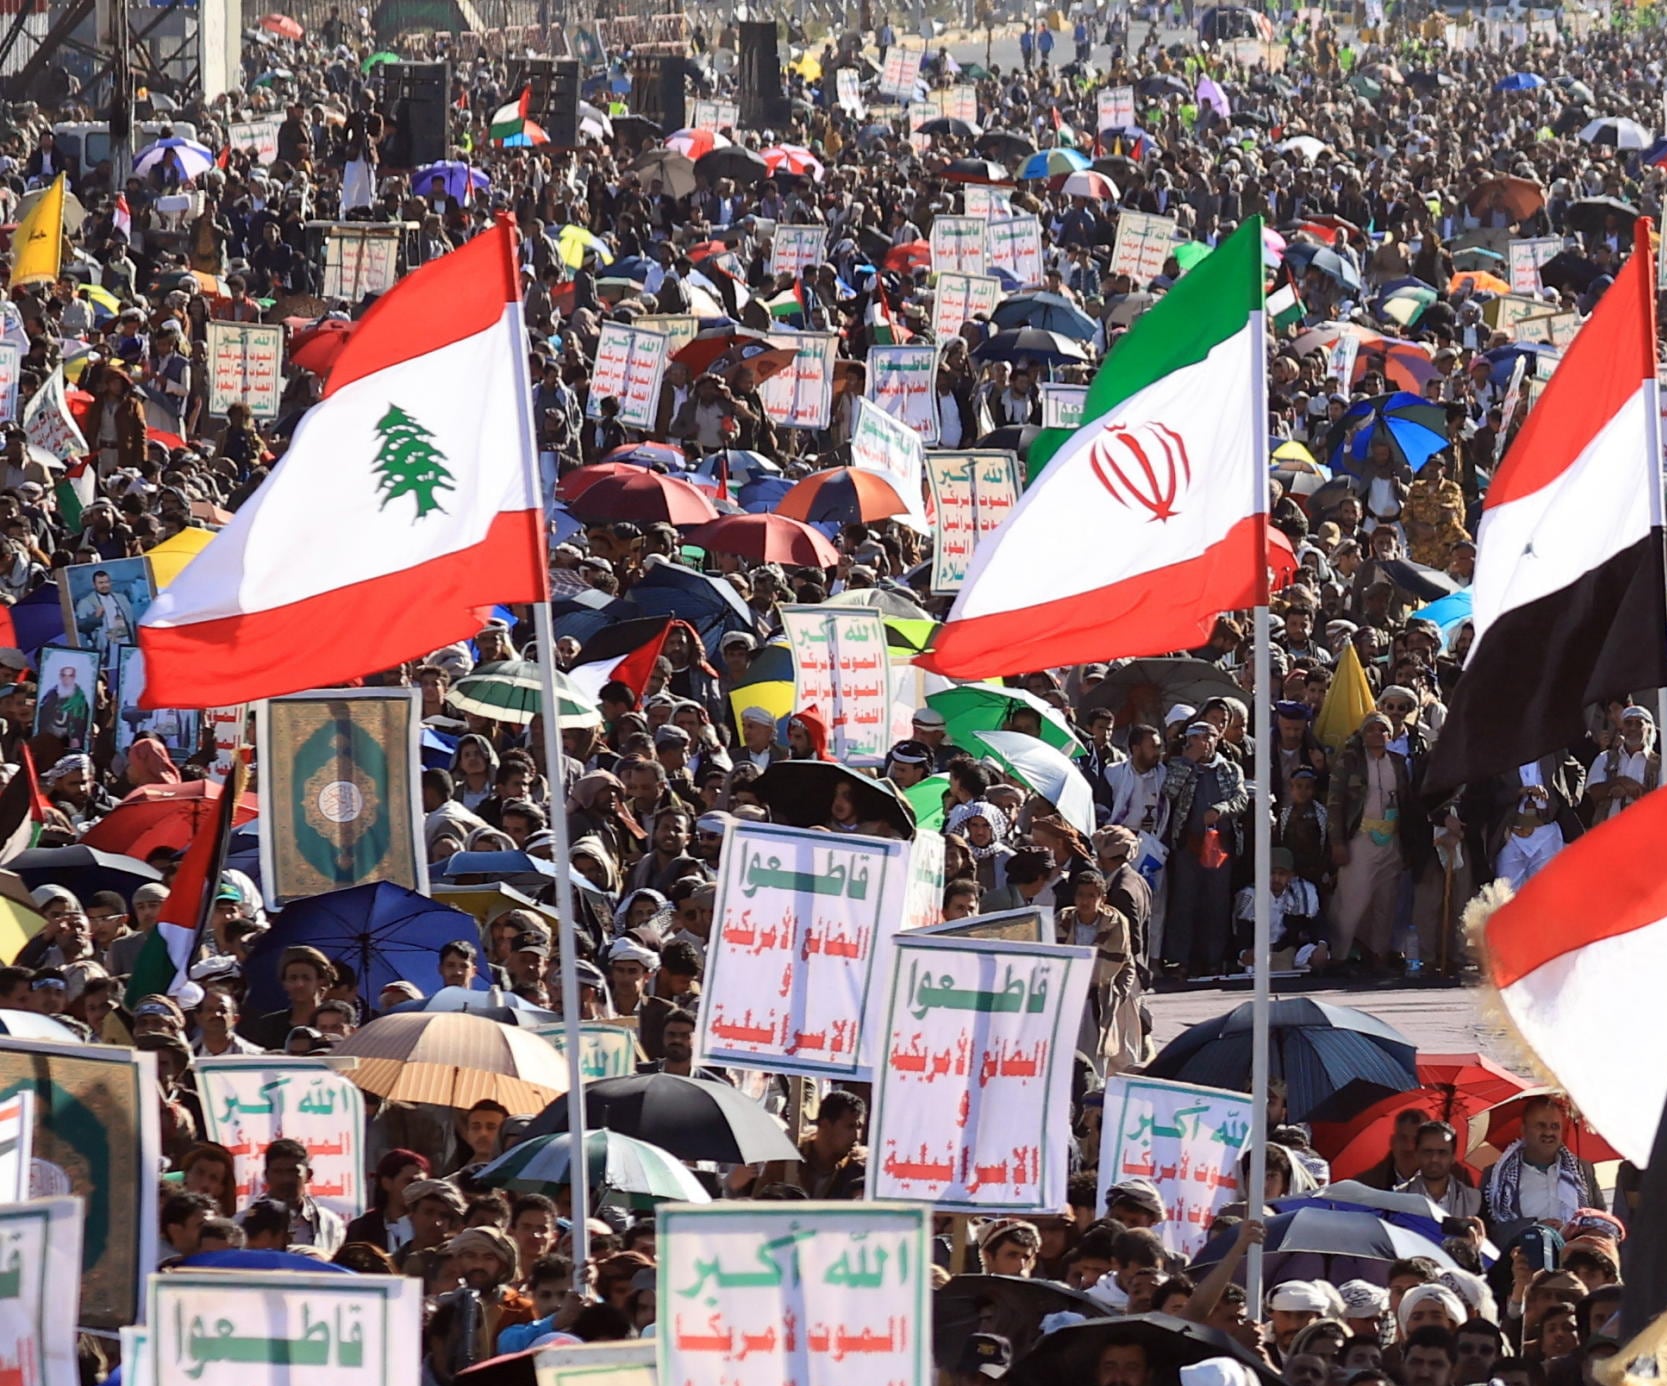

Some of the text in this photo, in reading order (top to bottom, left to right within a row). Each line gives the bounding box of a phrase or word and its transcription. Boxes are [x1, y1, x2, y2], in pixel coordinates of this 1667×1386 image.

[907, 958, 1050, 1021] قاطعوا
[674, 1220, 908, 1308] الله أكبر
[808, 1315, 906, 1363] الموت
